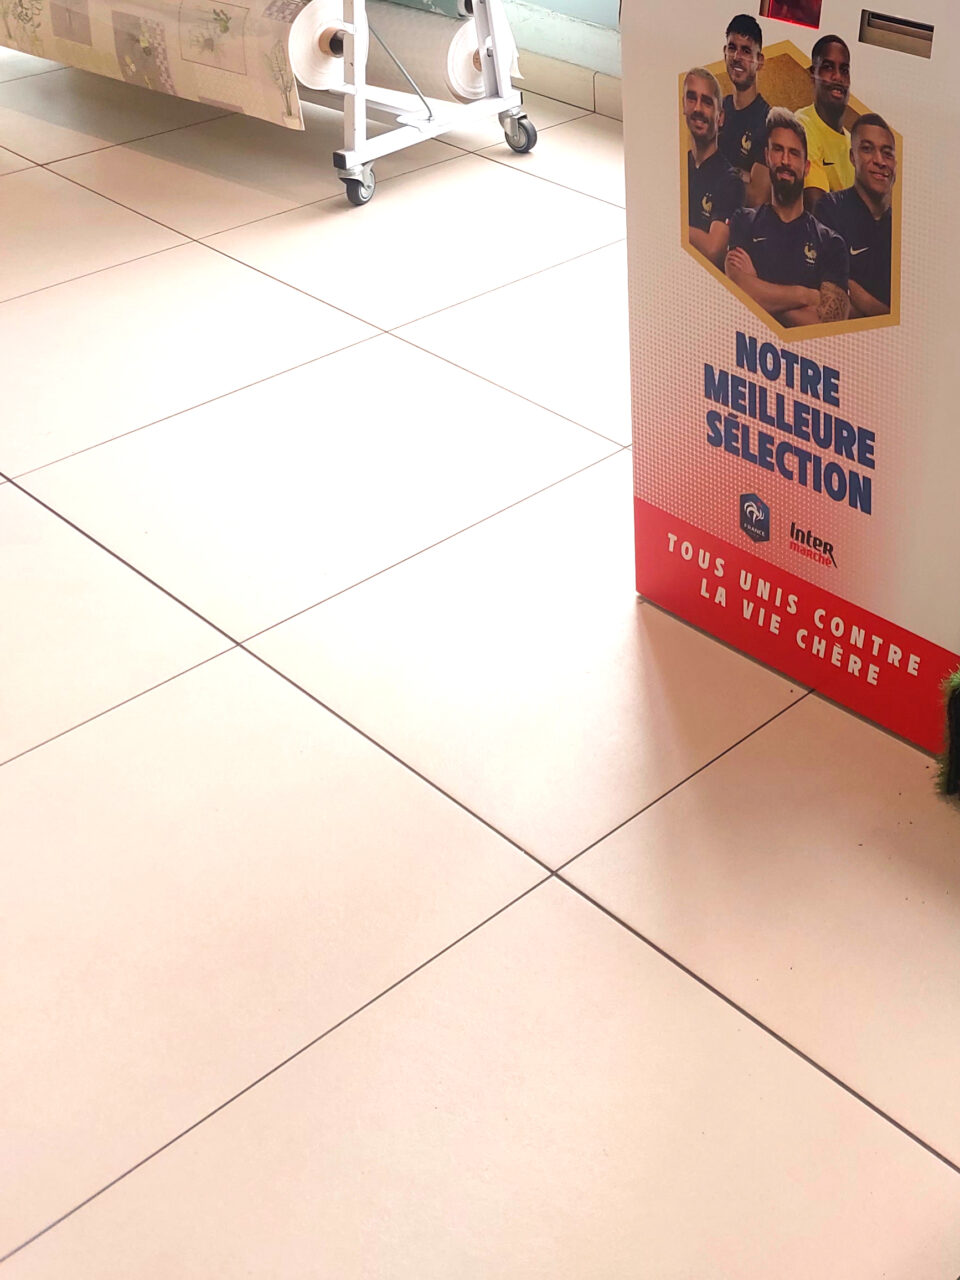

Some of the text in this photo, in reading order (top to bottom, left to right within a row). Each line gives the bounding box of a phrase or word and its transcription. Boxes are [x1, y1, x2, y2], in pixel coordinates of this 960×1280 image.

[704, 363, 875, 470] MEILLEURE
[736, 330, 840, 408] NOTRE
[706, 409, 872, 516] SÉLECTION
[790, 522, 837, 568] Inter
[667, 532, 921, 676] TOUS UNIS CONTRE
[700, 578, 880, 686] LA VIE CHÈRE
